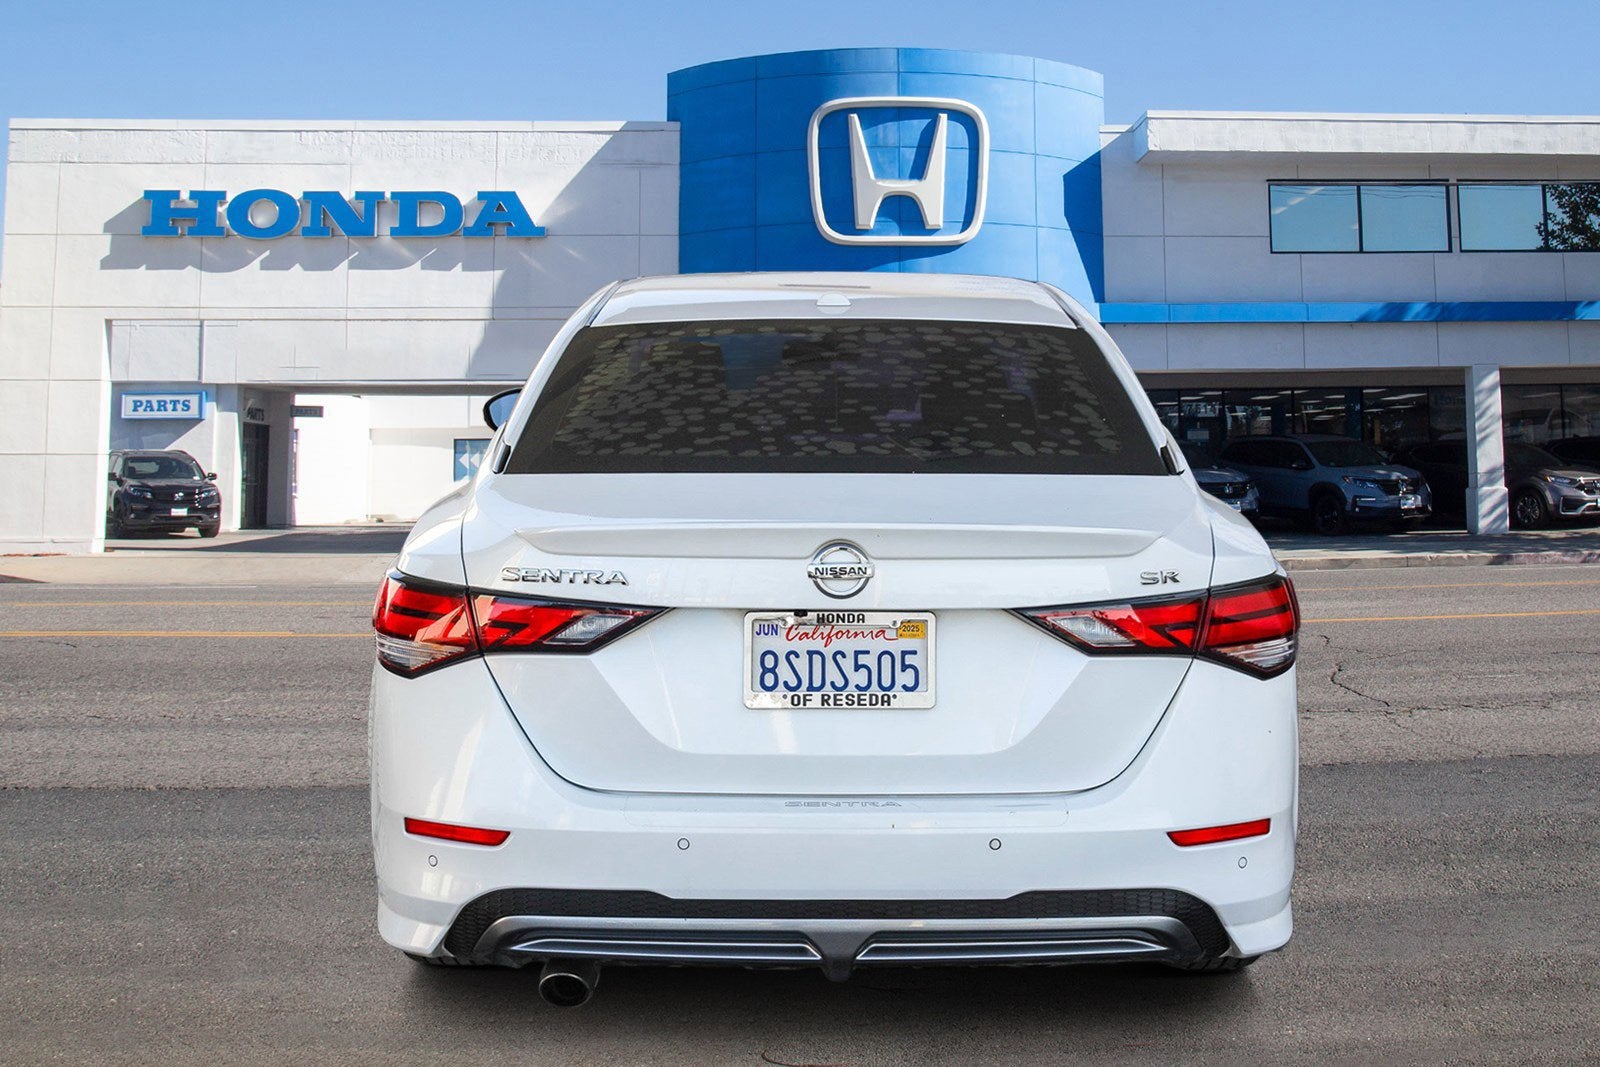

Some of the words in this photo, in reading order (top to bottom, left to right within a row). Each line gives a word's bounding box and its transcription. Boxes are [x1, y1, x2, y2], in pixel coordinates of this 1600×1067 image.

[142, 188, 547, 240] HONDA
[131, 399, 192, 413] PARTS
[501, 566, 630, 586] SENTRA
[813, 565, 869, 578] NISSAN
[1140, 570, 1181, 585] SR
[816, 612, 866, 624] HONDA
[755, 623, 779, 636] JUN
[902, 624, 921, 633] 2025
[785, 624, 898, 648] California
[759, 650, 920, 693] 8SDS505
[790, 693, 813, 707] OF
[820, 693, 892, 707] RESEDA
